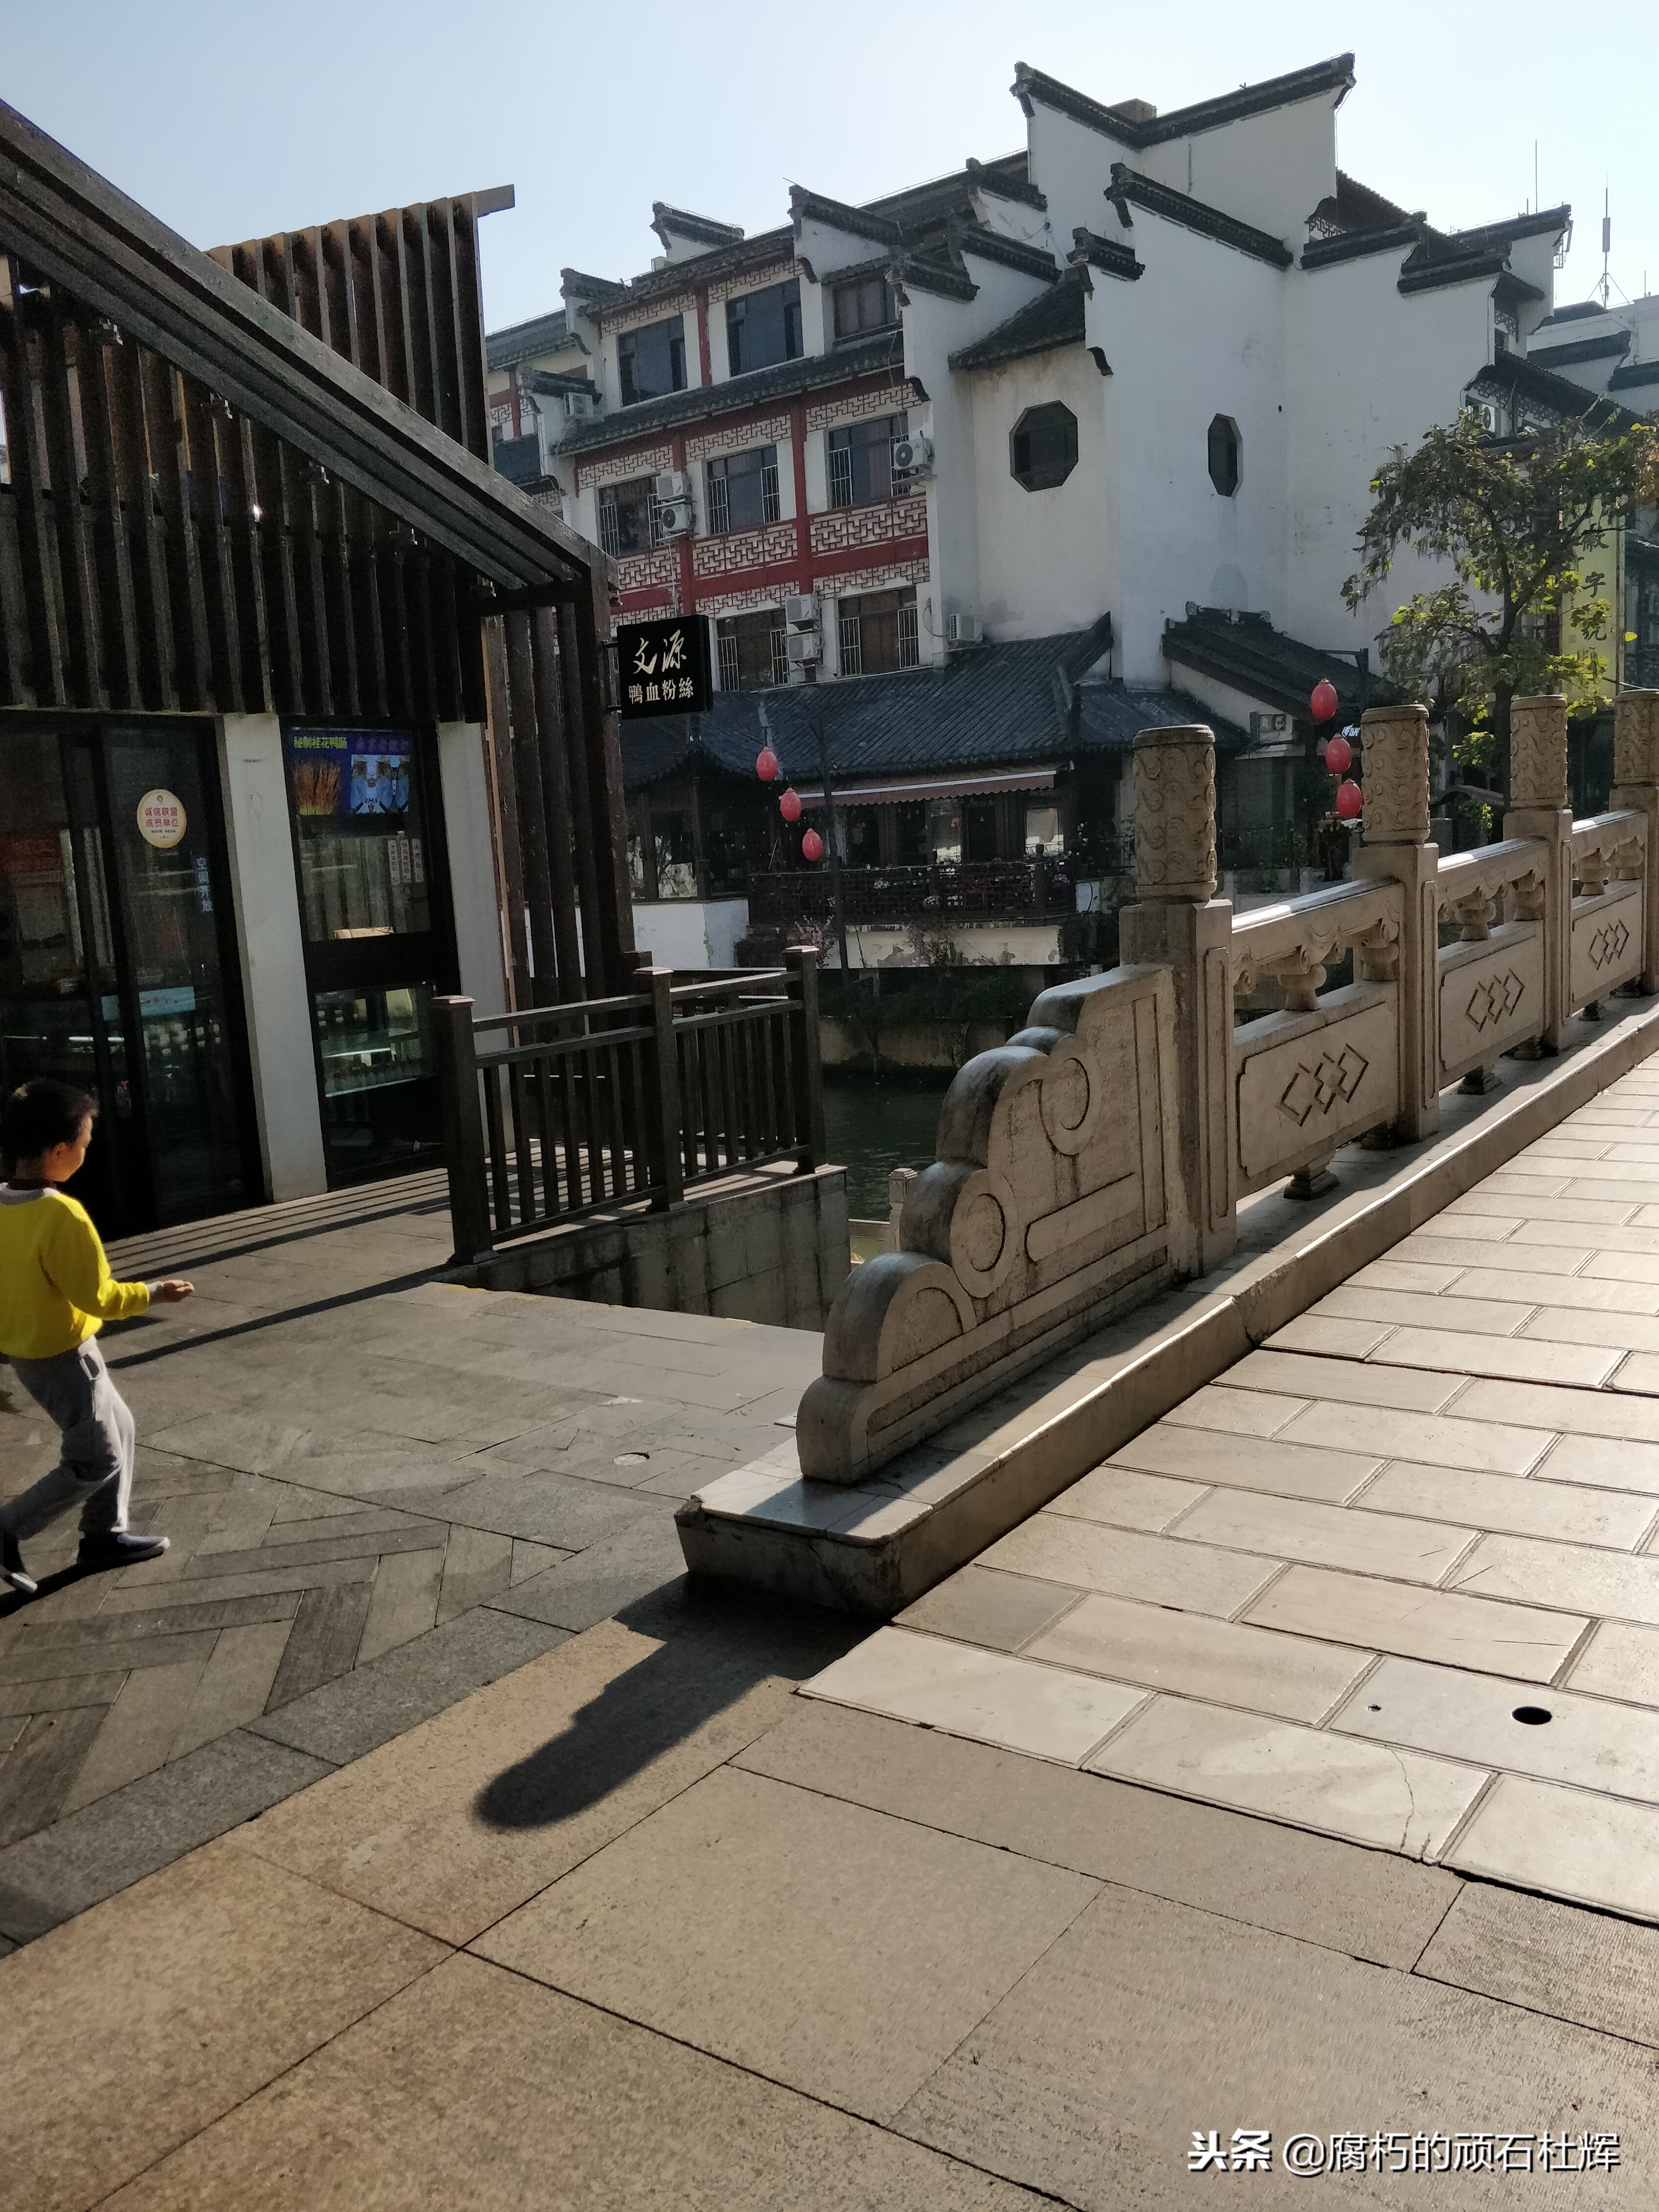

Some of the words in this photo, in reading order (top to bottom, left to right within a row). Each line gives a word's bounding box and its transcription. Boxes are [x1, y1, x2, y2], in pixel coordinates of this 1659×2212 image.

[633, 629, 686, 674] 文源
[628, 677, 694, 704] 鴨血粉絲
[293, 736, 347, 749] 秘制桂花鸭肠
[144, 807, 178, 816] 诚信联盟
[146, 818, 179, 827] 成员单位
[196, 857, 214, 912] 空调开放
